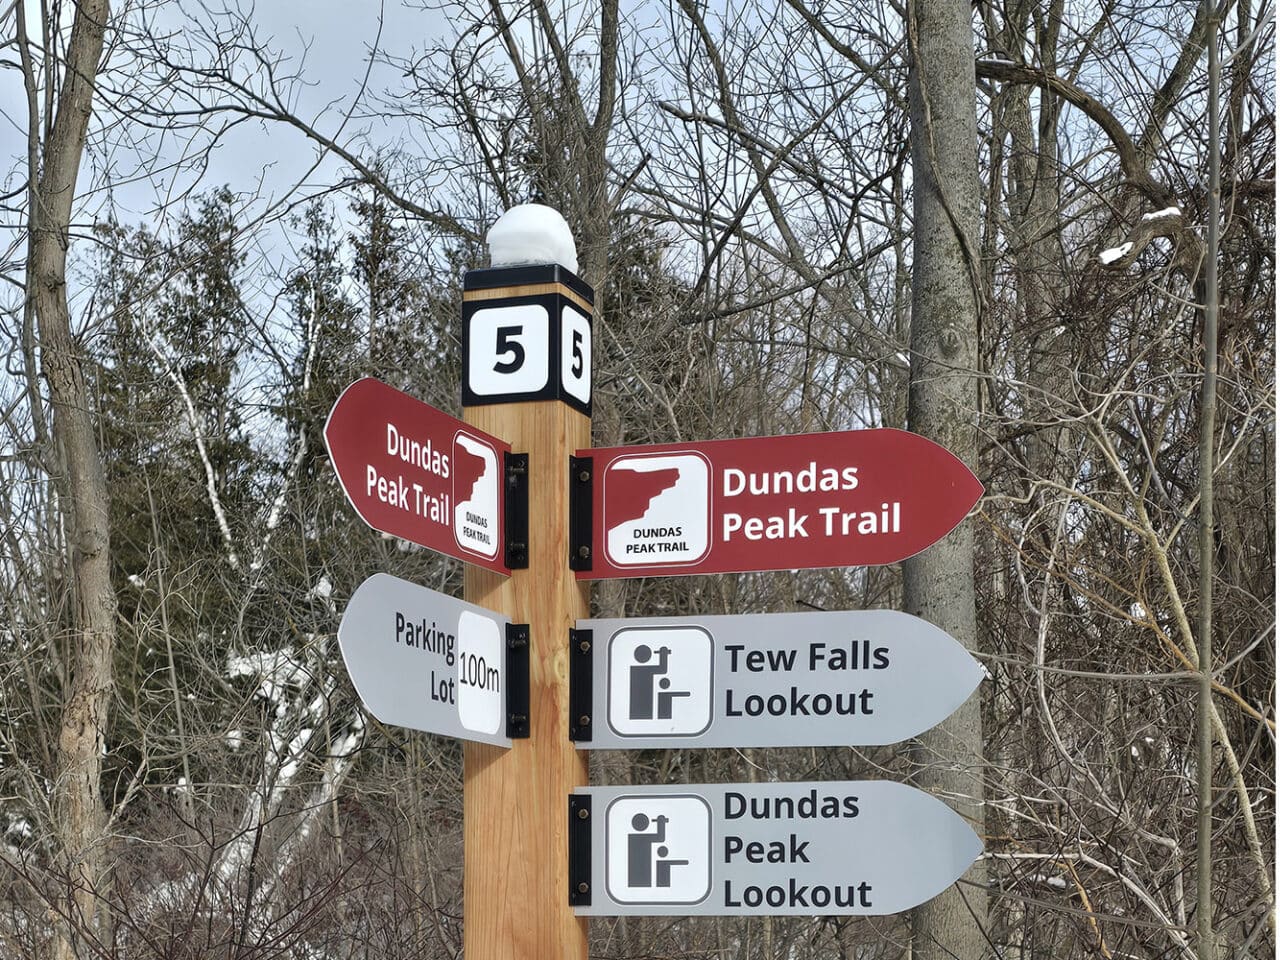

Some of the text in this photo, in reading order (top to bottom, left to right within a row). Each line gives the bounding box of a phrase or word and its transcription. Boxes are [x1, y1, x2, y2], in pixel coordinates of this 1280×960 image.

[493, 326, 525, 374] 5
[572, 330, 583, 379] 5
[388, 424, 449, 480] Dundas
[367, 465, 449, 525] Peak Trail
[724, 462, 858, 496] Dundas
[464, 527, 490, 544] PEAK TRAIL
[466, 512, 488, 530] DUNDAS
[634, 527, 681, 538] DUNDAS
[724, 503, 899, 541] Peak Trail
[627, 542, 689, 553] PEAK TRAIL
[396, 612, 454, 666] Parking
[460, 652, 499, 692] 100m
[725, 640, 889, 672] Tew Falls
[432, 671, 454, 704] Lot
[726, 687, 873, 716] Lookout
[725, 791, 859, 820] Dundas
[725, 834, 810, 863] Peak
[725, 879, 872, 907] Lookout
